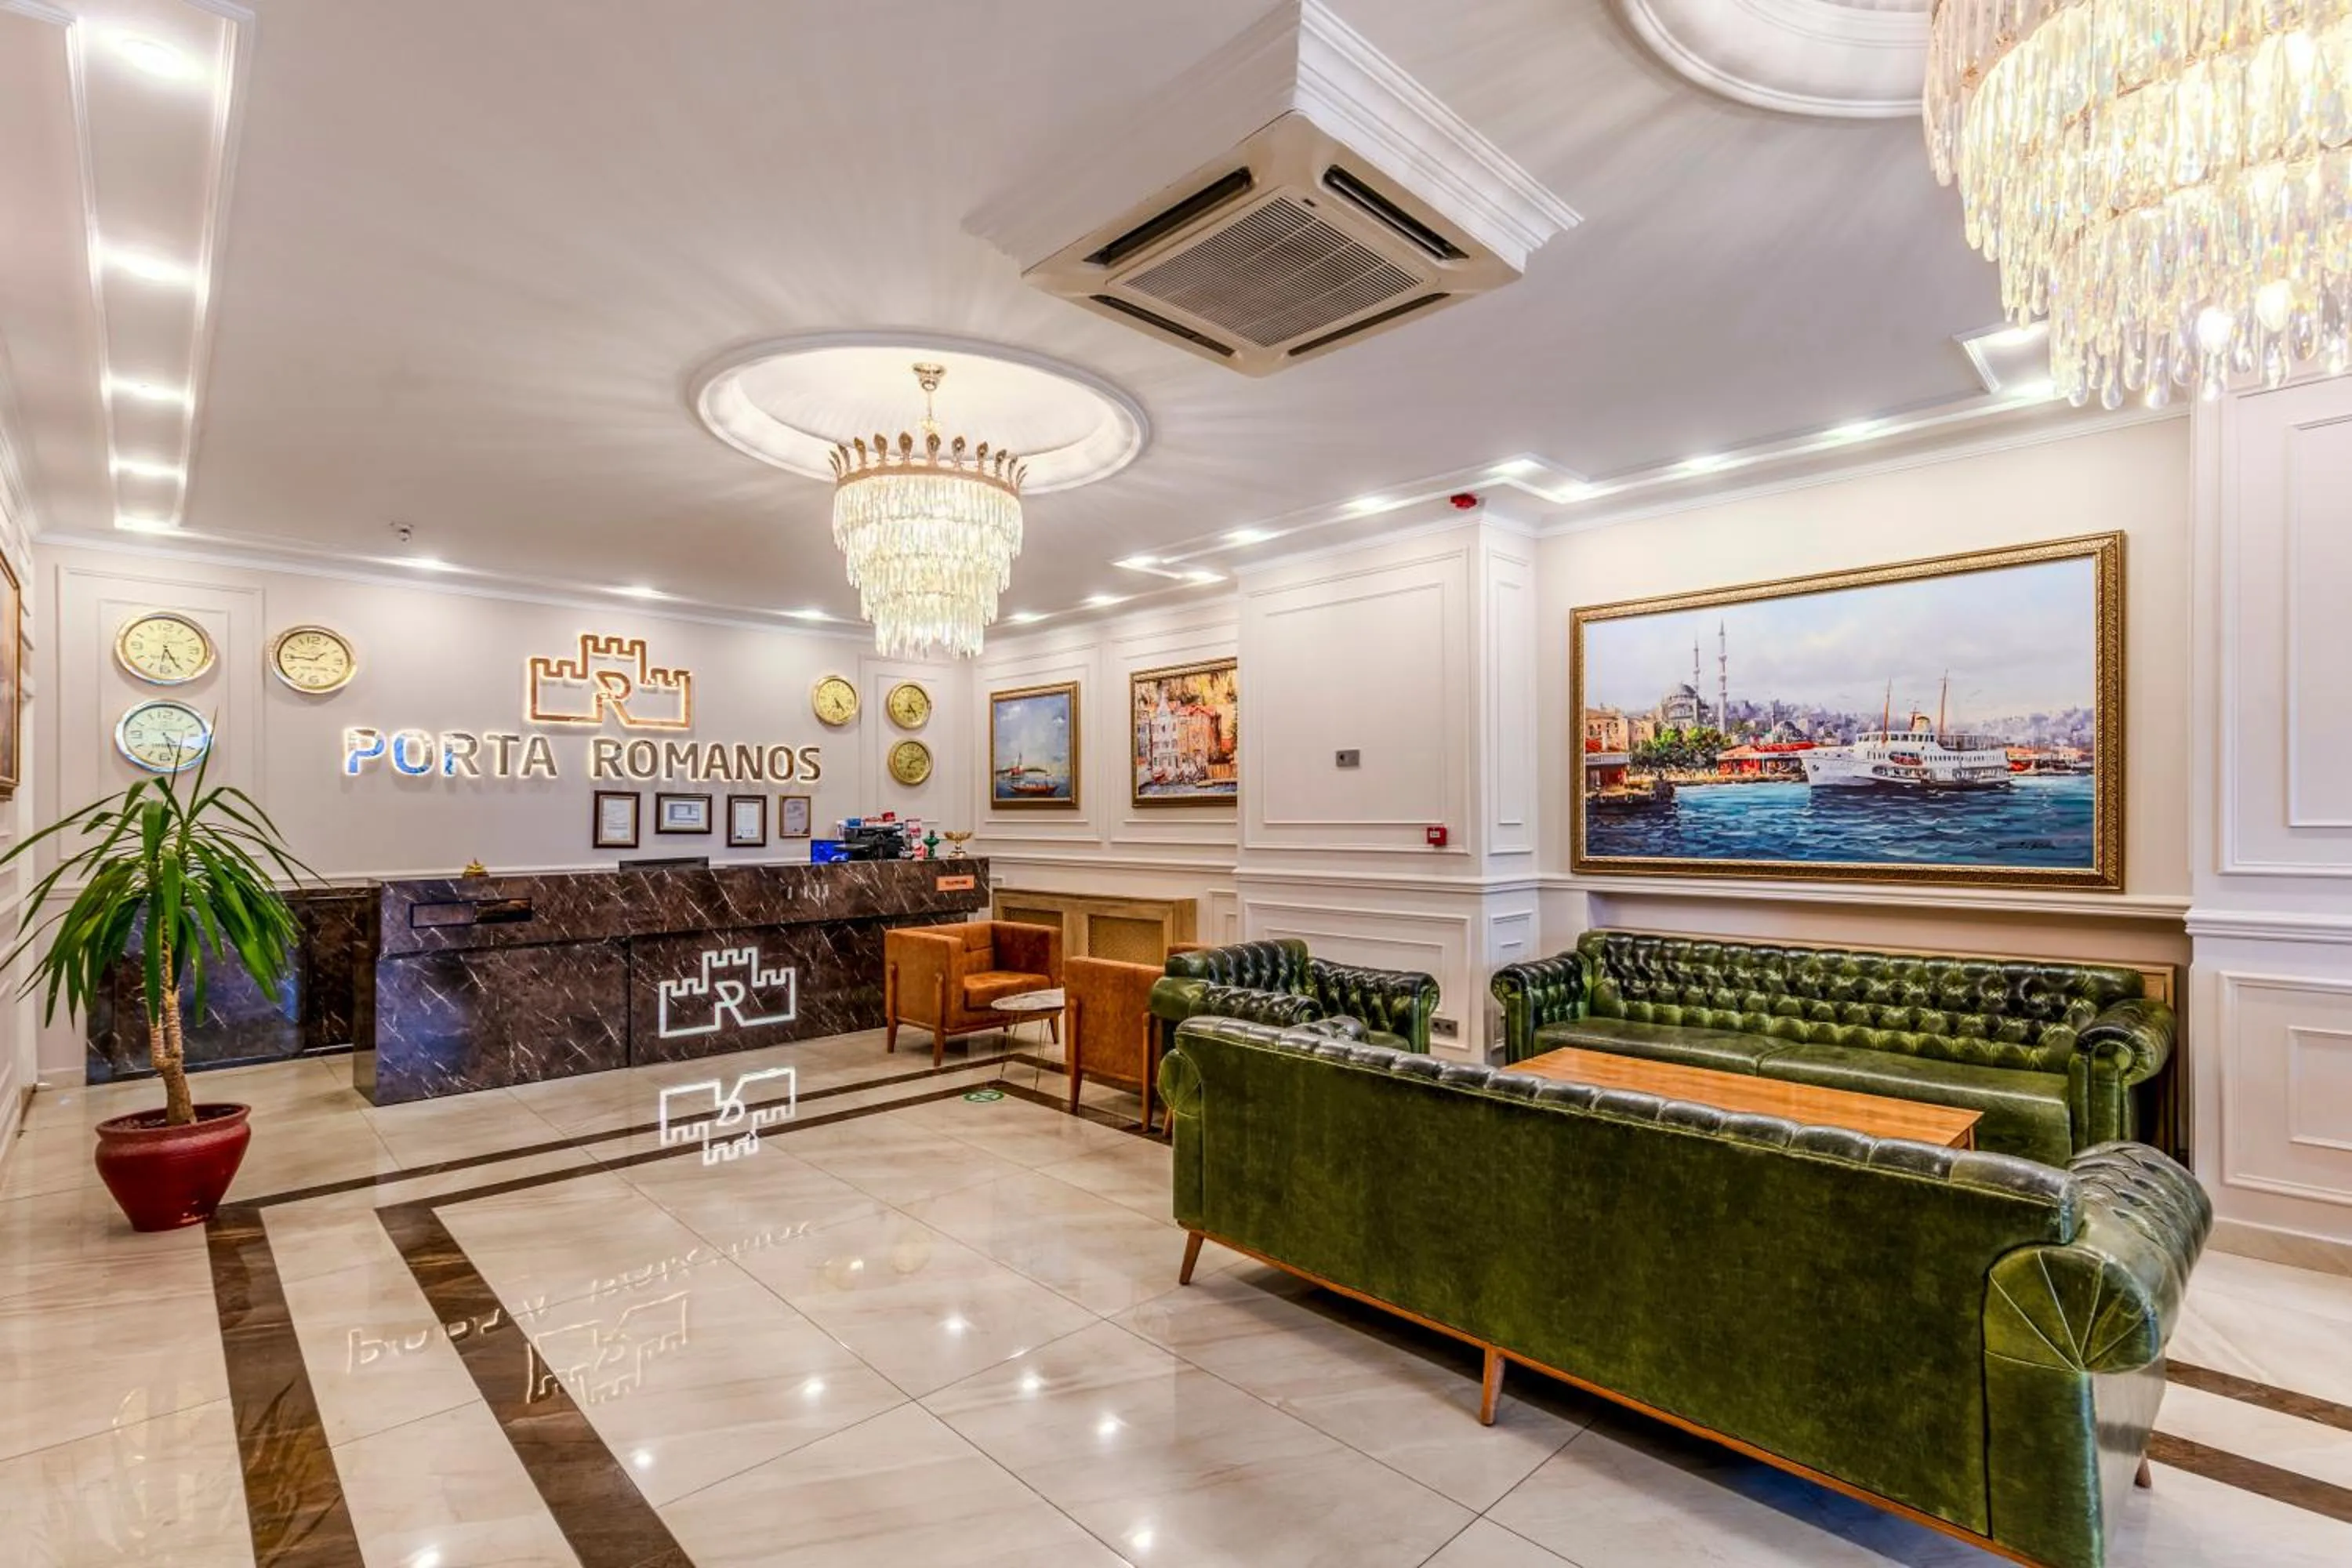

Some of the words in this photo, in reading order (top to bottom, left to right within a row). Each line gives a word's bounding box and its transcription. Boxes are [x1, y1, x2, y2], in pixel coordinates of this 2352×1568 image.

[307, 636, 321, 645] 12
[345, 728, 558, 776] PORTA
[591, 738, 821, 782] ROMANOS
